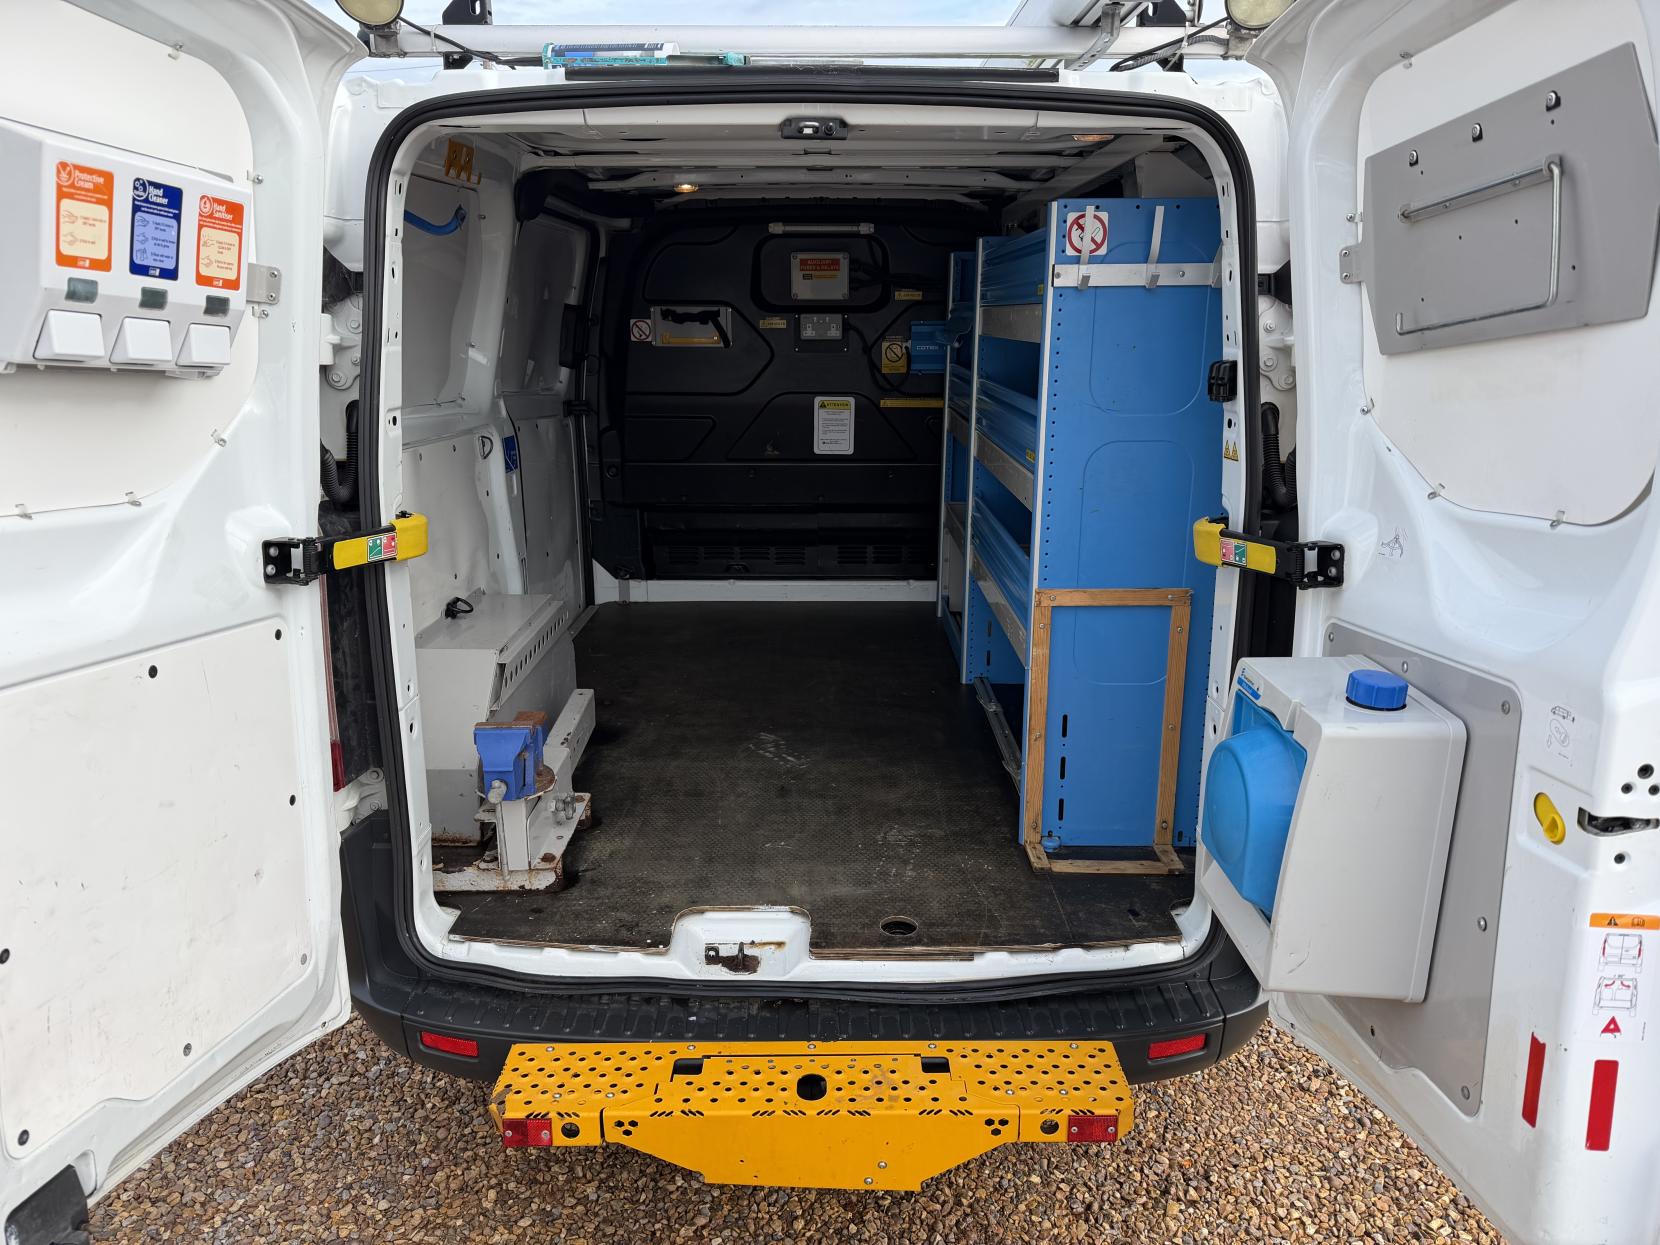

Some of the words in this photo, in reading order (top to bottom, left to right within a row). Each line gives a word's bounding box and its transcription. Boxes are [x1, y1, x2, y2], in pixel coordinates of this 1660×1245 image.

[75, 170, 104, 185] Protective
[75, 179, 94, 189] Cream
[148, 186, 164, 197] Hand
[148, 194, 168, 205] Cleaner
[213, 202, 226, 211] Hand
